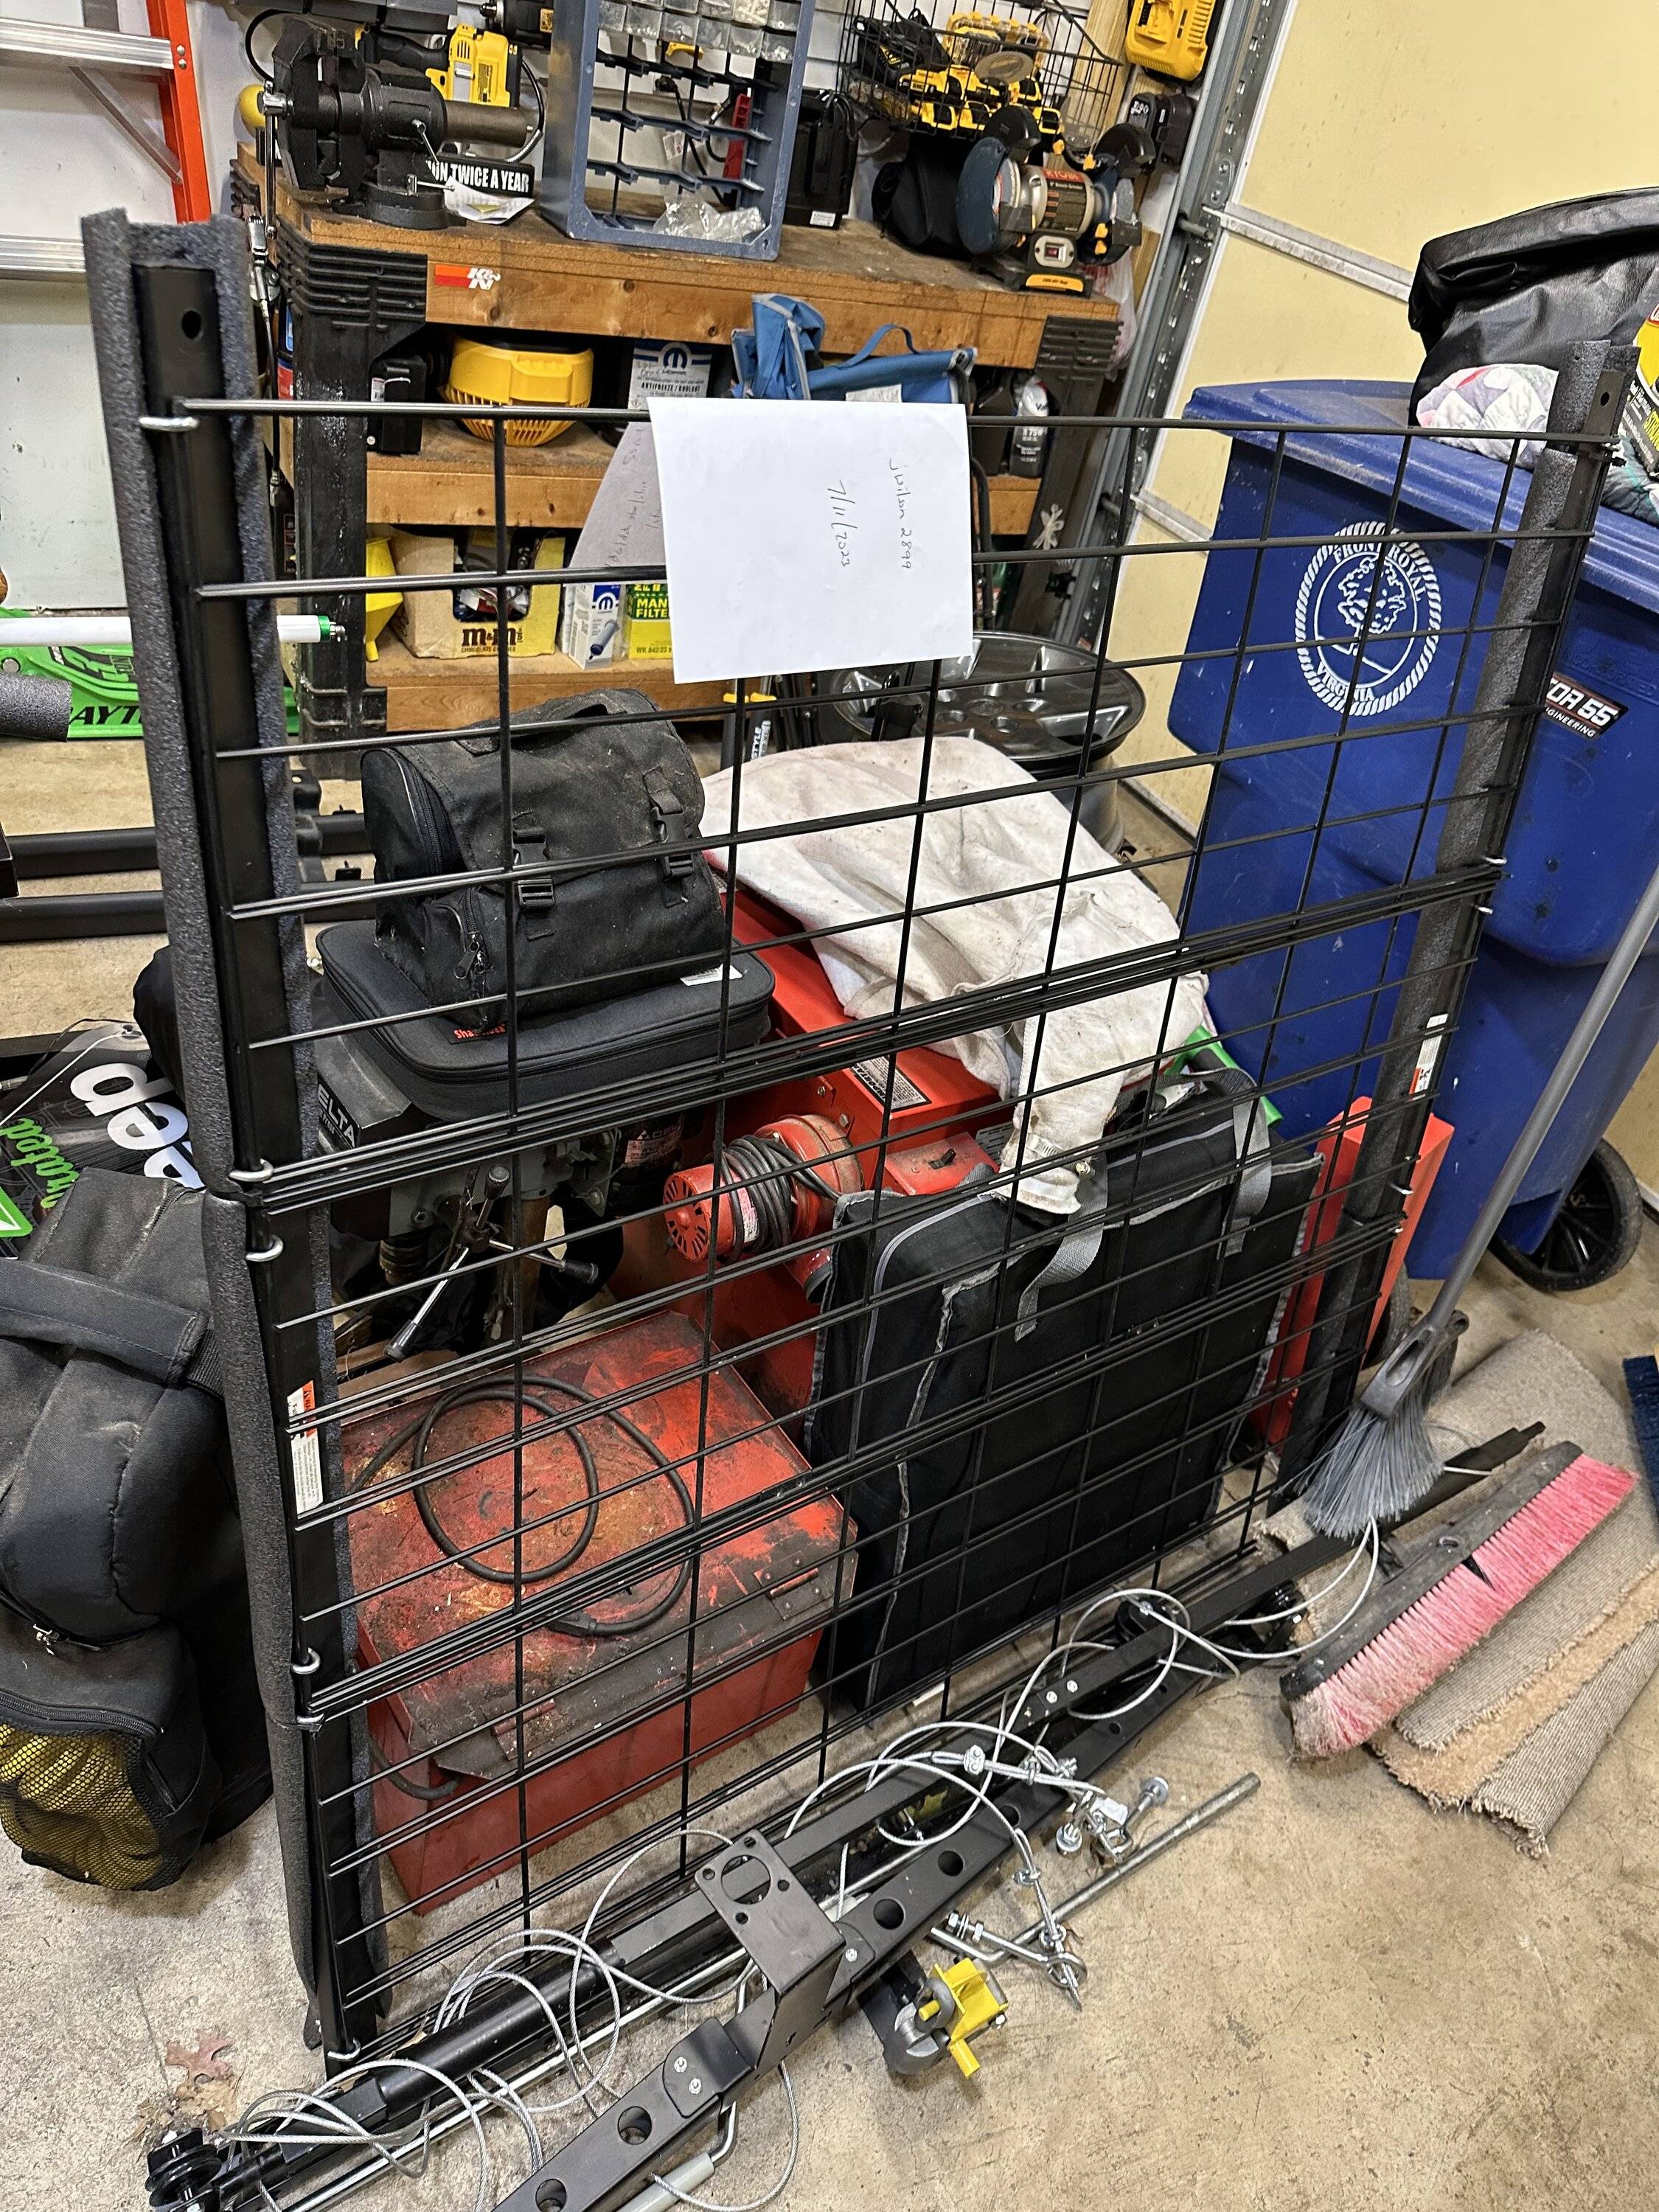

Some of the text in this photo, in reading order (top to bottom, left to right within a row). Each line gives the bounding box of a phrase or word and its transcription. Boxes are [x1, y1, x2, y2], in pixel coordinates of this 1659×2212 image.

[451, 164, 489, 187] TWICE
[490, 168, 499, 189] A
[501, 170, 529, 193] YEAR
[827, 479, 858, 567] 7/11/2023
[900, 527, 912, 569] 2899
[1388, 544, 1426, 602] ROYAL
[636, 598, 667, 608] MAN
[636, 609, 668, 619] FILTE
[69, 705, 142, 725] AYT
[1546, 677, 1618, 727] OR 55
[1545, 707, 1597, 737] GINEERING
[854, 1063, 886, 1099] IMPORTAN
[70, 1062, 207, 1192] eep
[318, 1083, 355, 1148] ELTA
